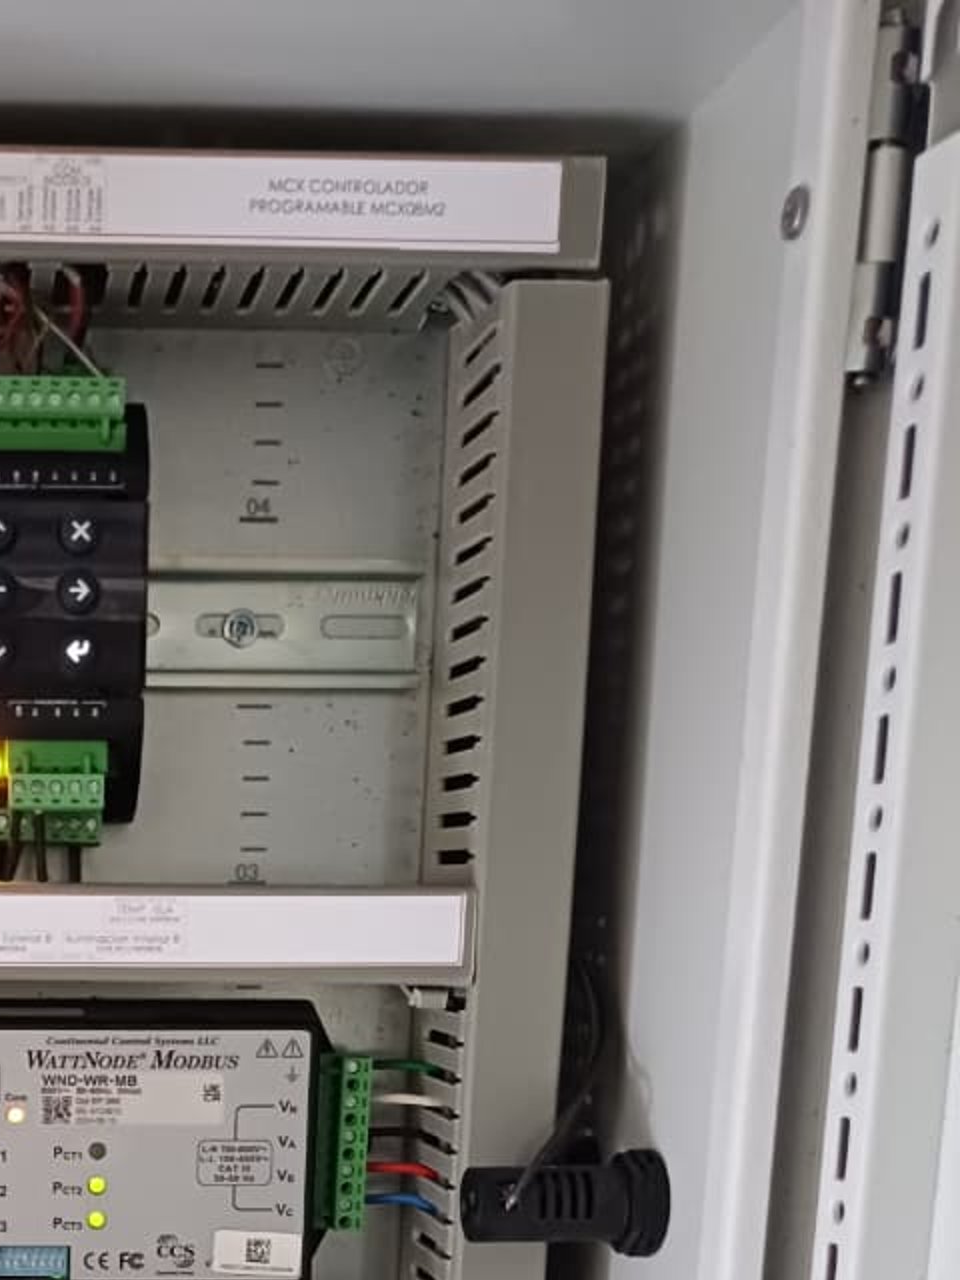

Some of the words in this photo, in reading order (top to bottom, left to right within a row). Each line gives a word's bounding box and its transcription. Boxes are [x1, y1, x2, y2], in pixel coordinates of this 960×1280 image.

[269, 178, 304, 193] MCX
[309, 178, 429, 195] CONTROLADOR
[249, 198, 367, 215] PROGRAMABLE
[41, 1074, 138, 1087] WND-WR-MB
[157, 1245, 196, 1259] CCS
